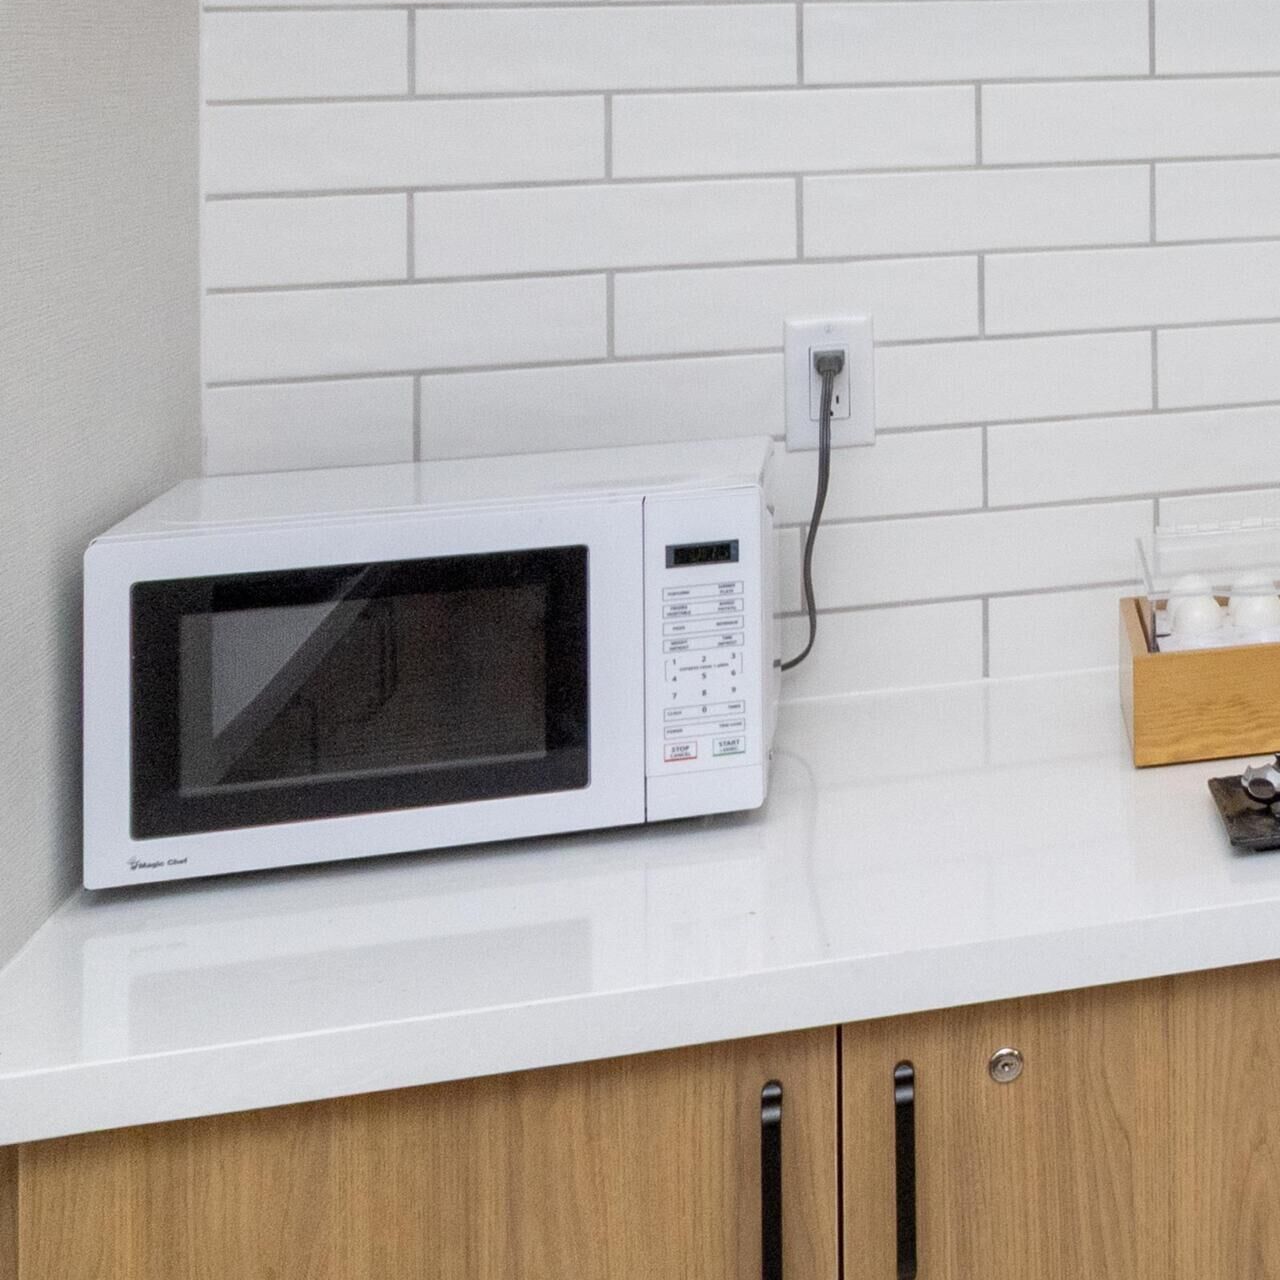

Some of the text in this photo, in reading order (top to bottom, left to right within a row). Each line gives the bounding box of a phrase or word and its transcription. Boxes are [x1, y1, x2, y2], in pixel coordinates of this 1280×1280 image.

[718, 739, 740, 747] START
[671, 745, 690, 753] STOP
[167, 857, 188, 866] Chef
